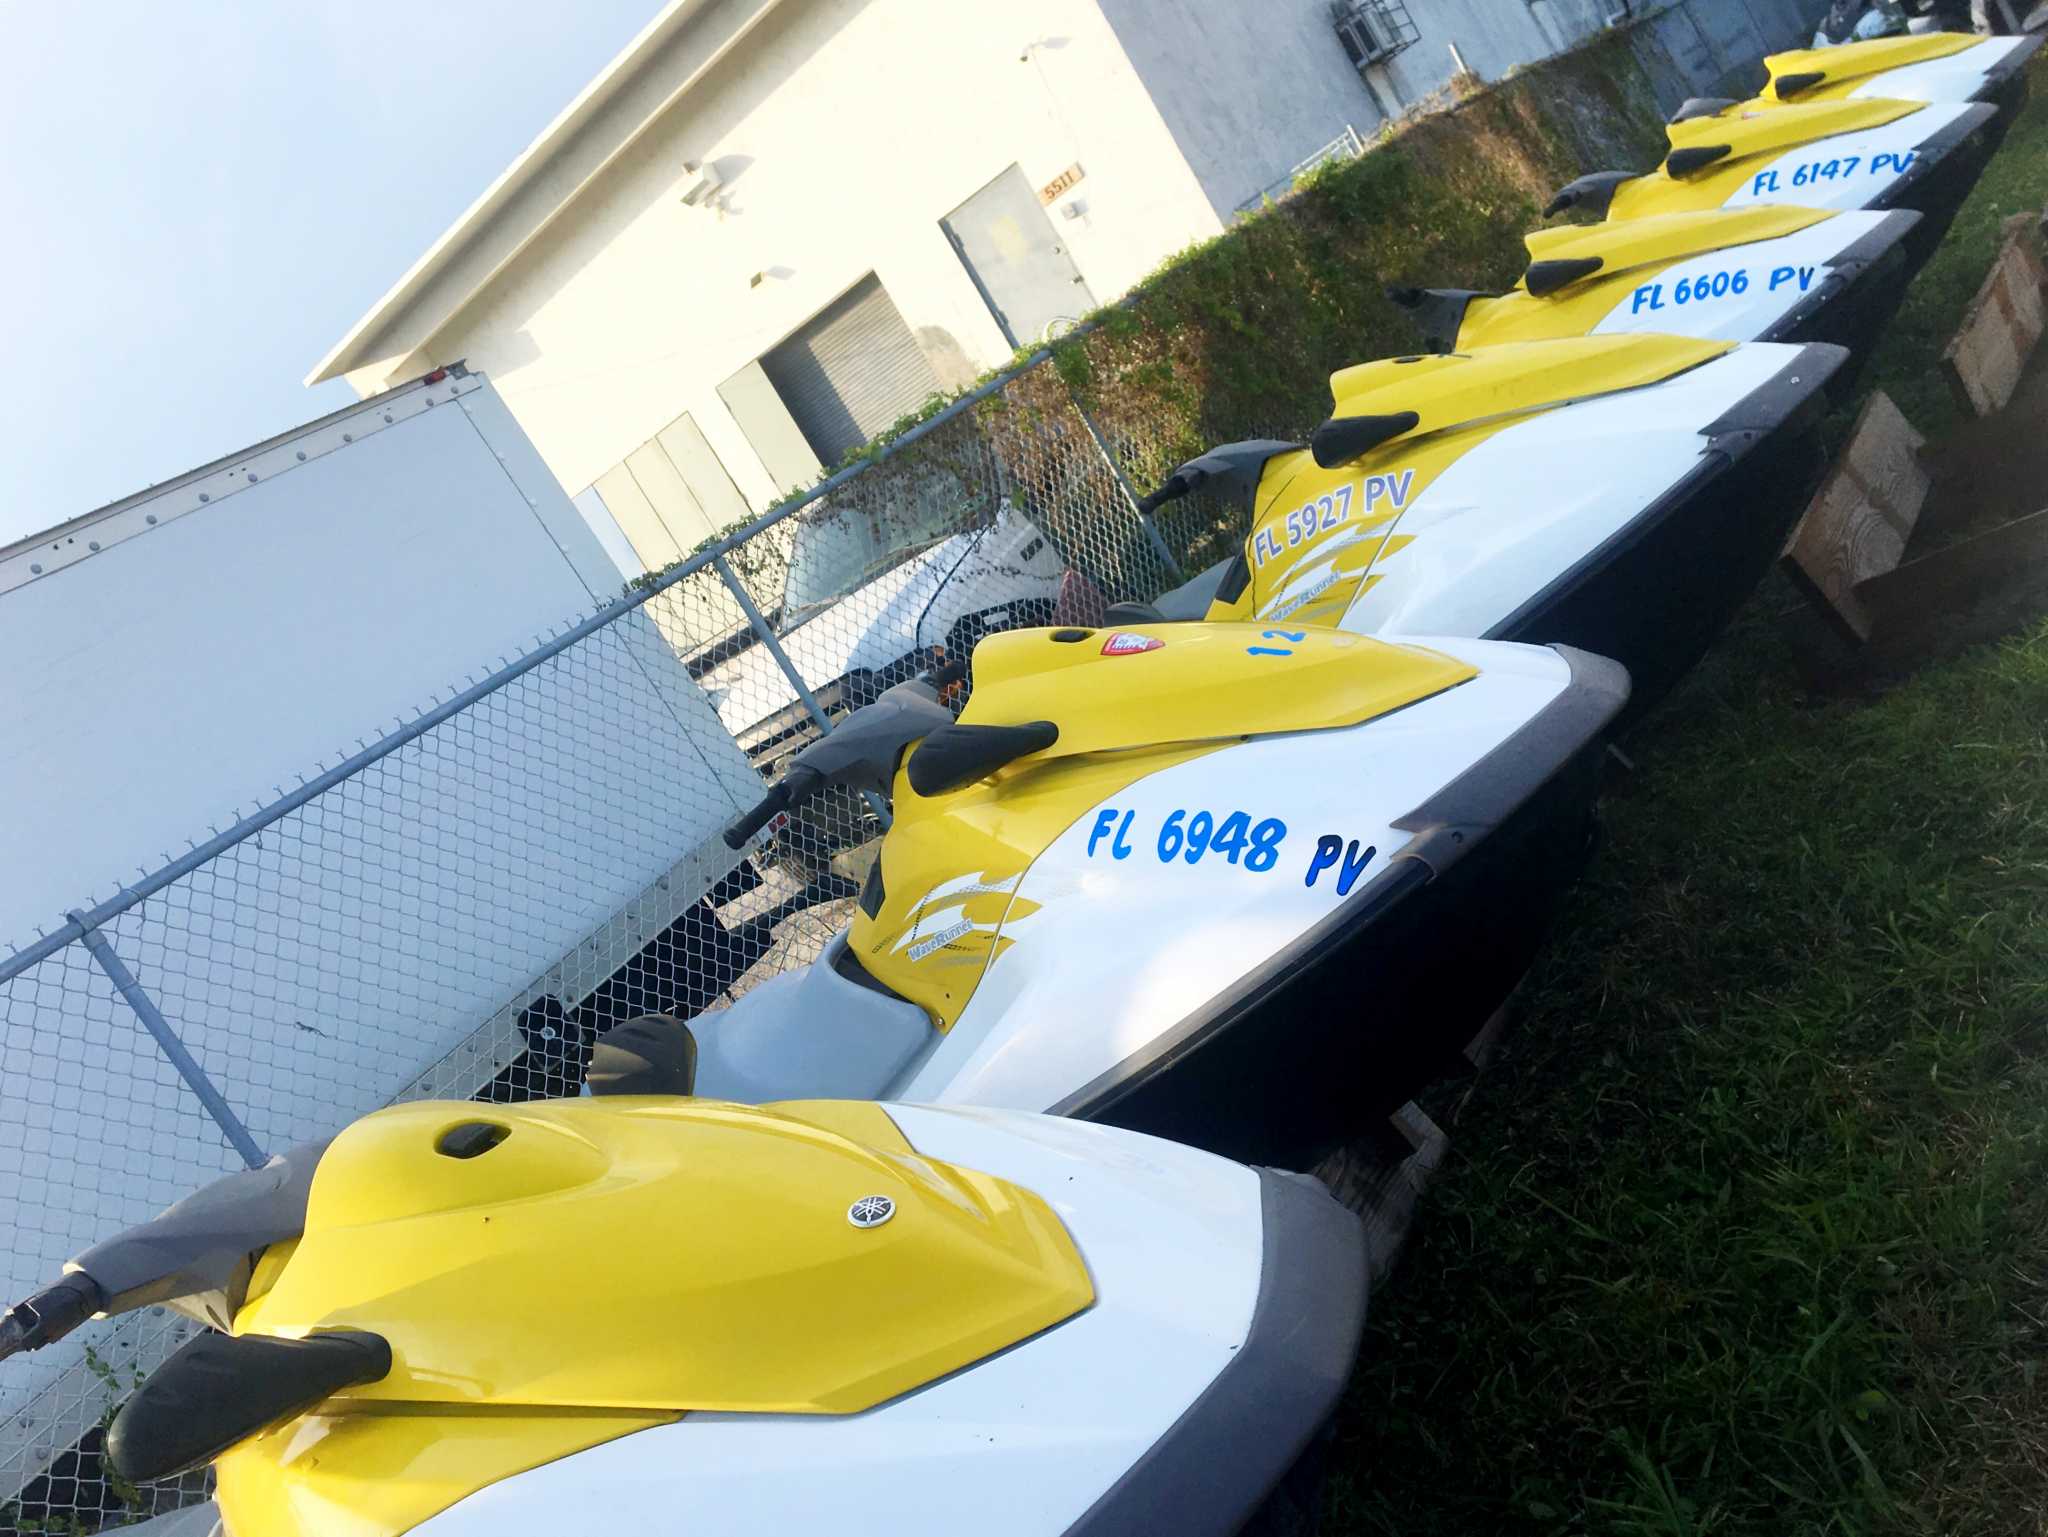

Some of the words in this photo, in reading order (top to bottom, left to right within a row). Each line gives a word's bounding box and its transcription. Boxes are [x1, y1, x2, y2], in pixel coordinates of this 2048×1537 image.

[1044, 170, 1075, 199] 5511
[1753, 170, 1780, 196] FL
[1791, 156, 1862, 187] 6147
[1870, 151, 1915, 176] PV
[1631, 283, 1665, 316] FL
[1674, 269, 1749, 305] 6606
[1768, 266, 1814, 292] PV
[1253, 527, 1284, 567] FL
[1287, 485, 1353, 547] 5927
[1365, 470, 1414, 512] PV
[1088, 809, 1136, 861] FL
[1157, 809, 1288, 873] 6948
[1304, 834, 1377, 897] PV
[908, 918, 974, 961] WaveRunner
